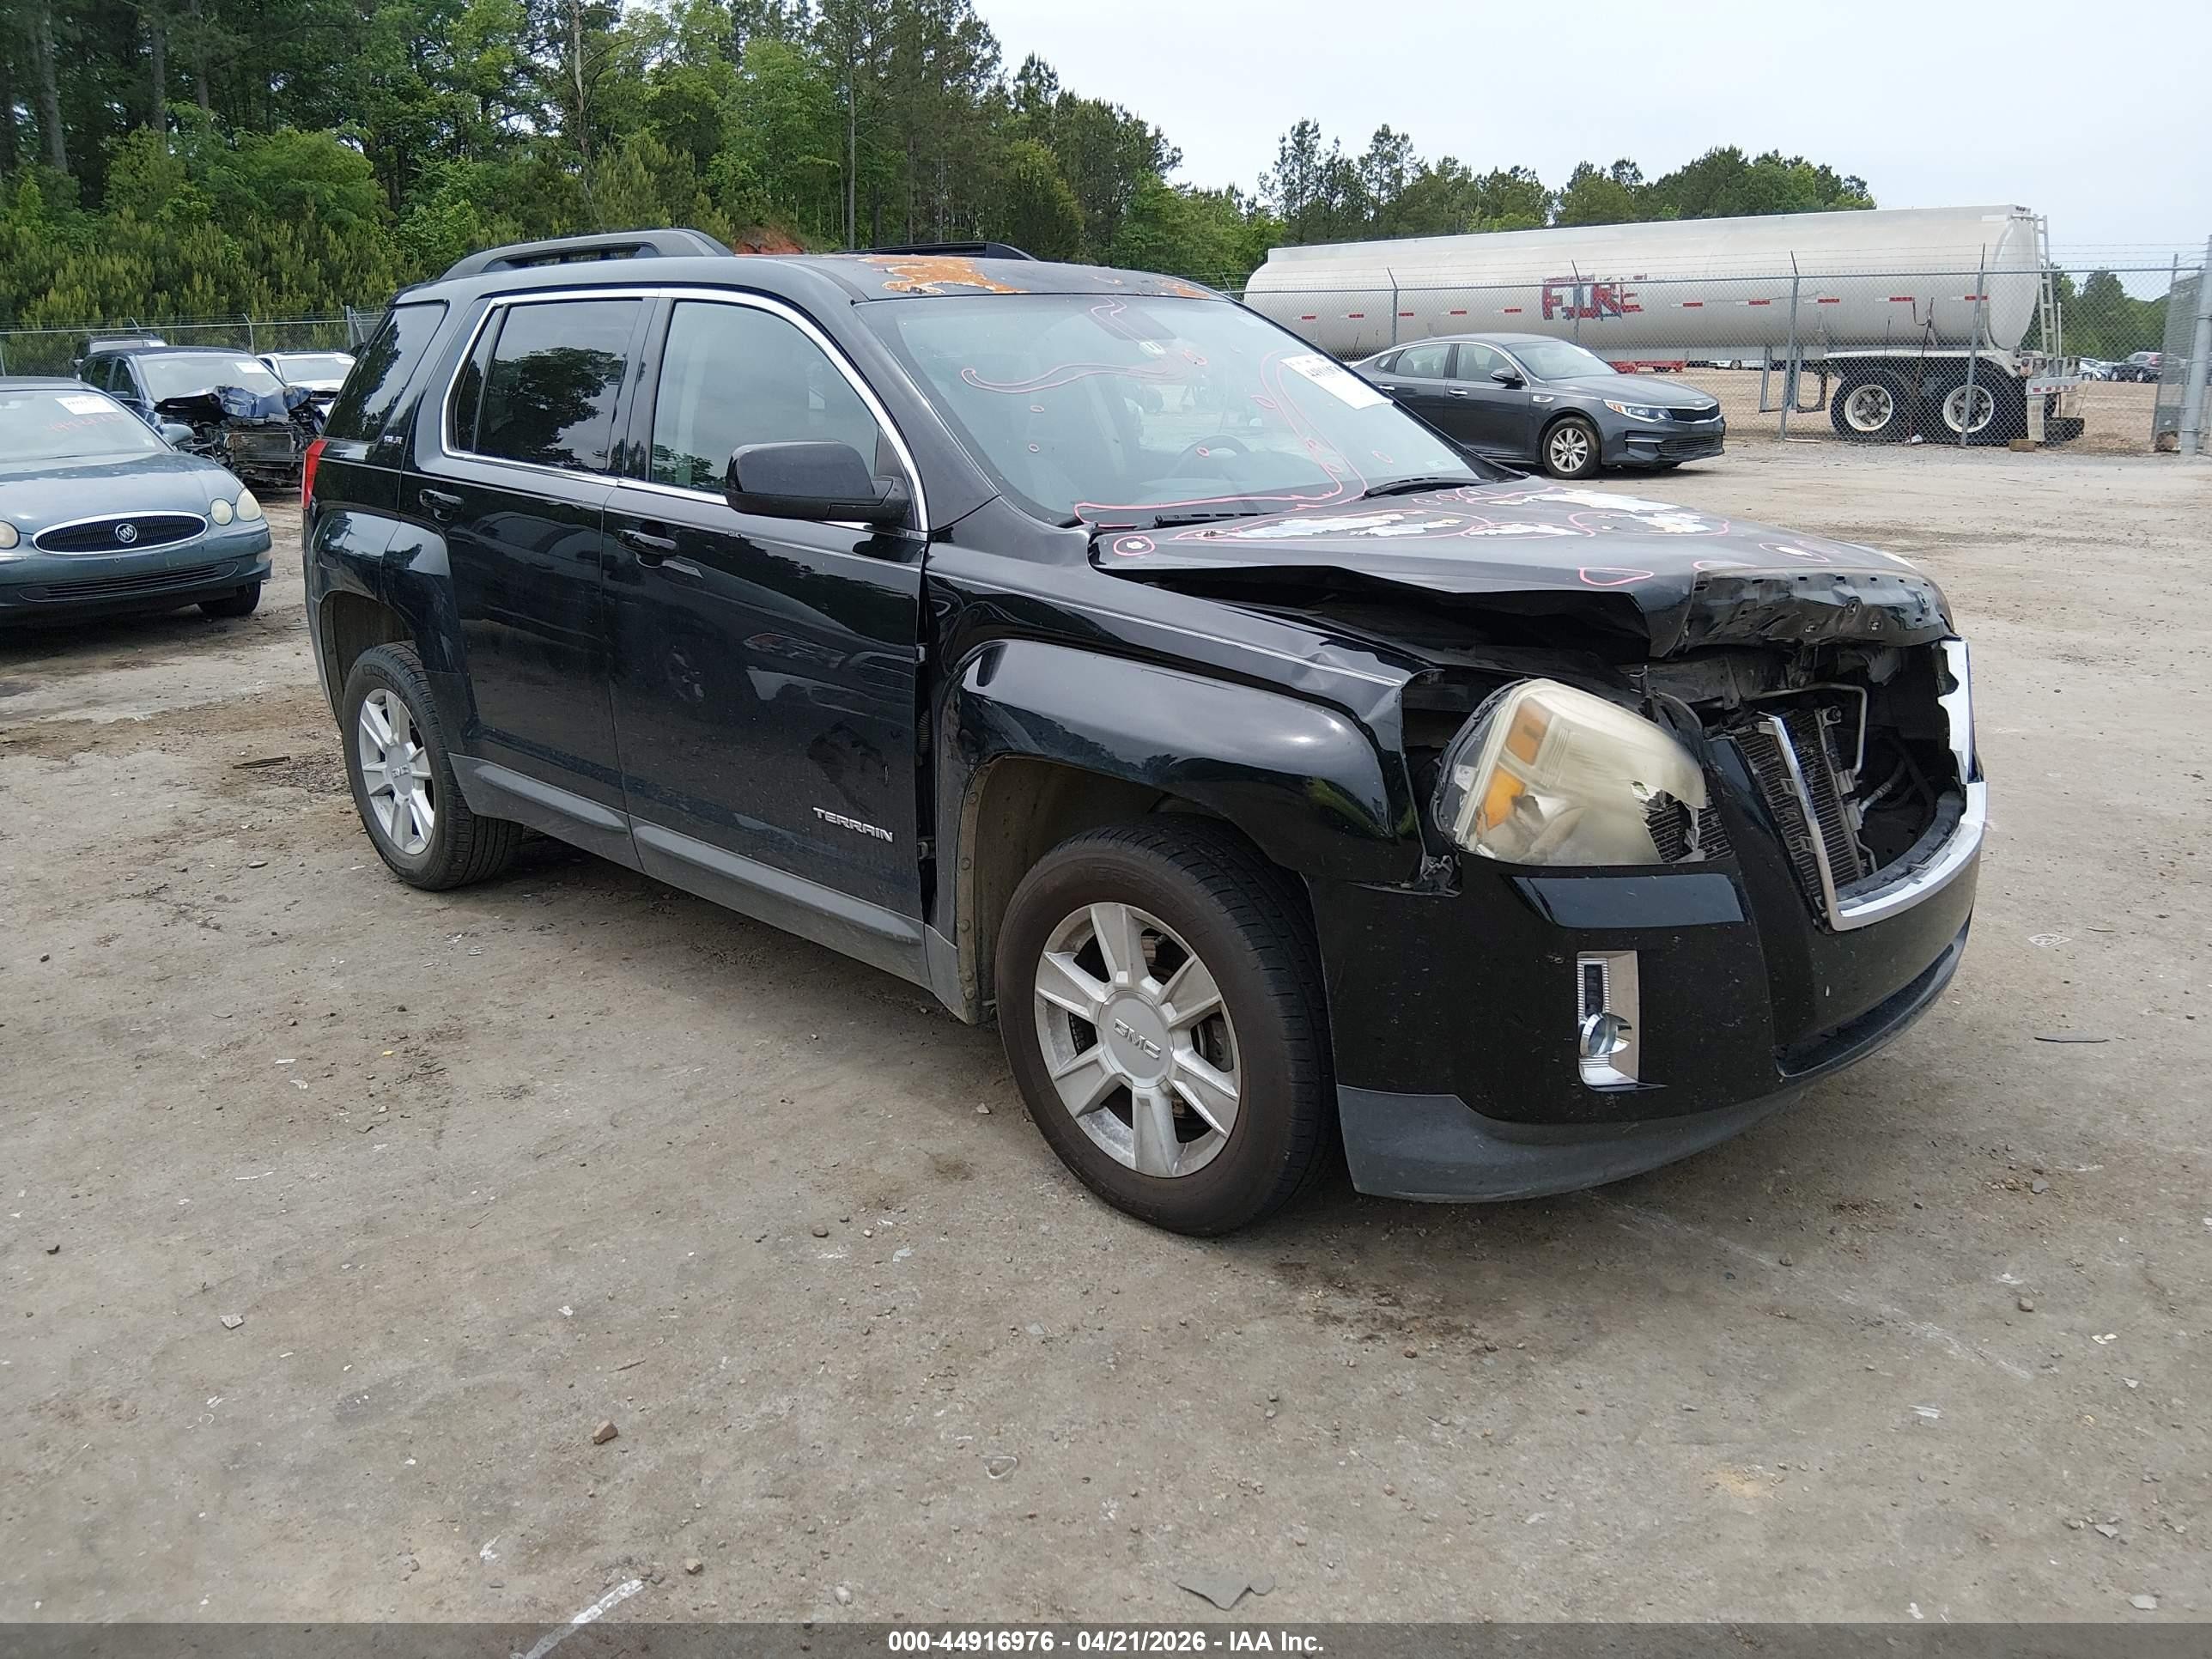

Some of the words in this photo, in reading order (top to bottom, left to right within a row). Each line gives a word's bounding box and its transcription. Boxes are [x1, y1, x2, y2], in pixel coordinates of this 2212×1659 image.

[1542, 274, 1645, 321] FIRE
[812, 807, 893, 842] TERRAIN
[1114, 1018, 1161, 1060] GMC
